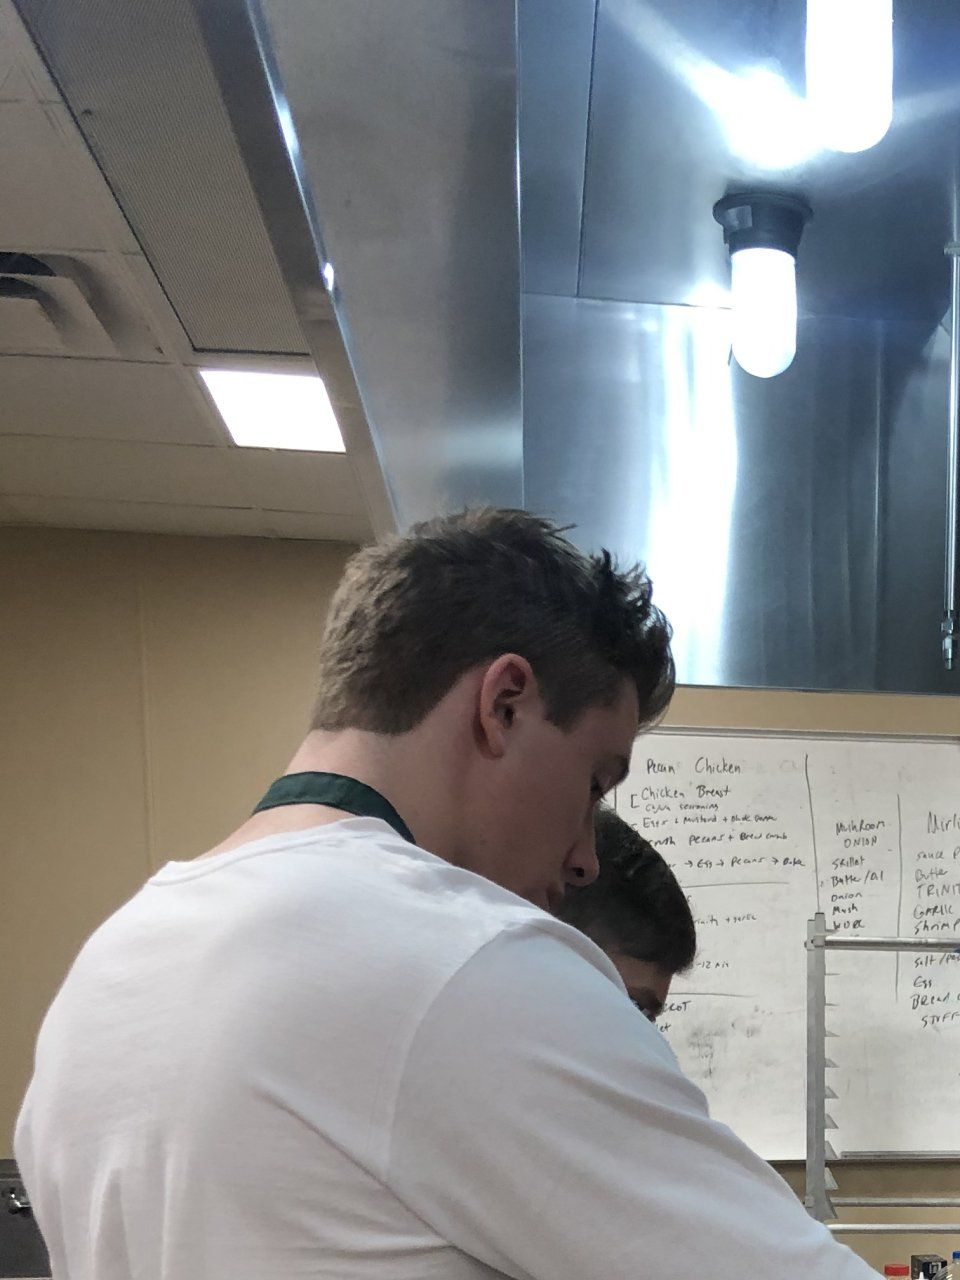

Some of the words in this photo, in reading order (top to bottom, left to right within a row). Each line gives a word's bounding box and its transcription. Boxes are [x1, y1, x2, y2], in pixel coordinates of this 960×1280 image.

[695, 756, 741, 775] Chicken
[641, 786, 685, 800] Chicken
[696, 784, 731, 798] Breast
